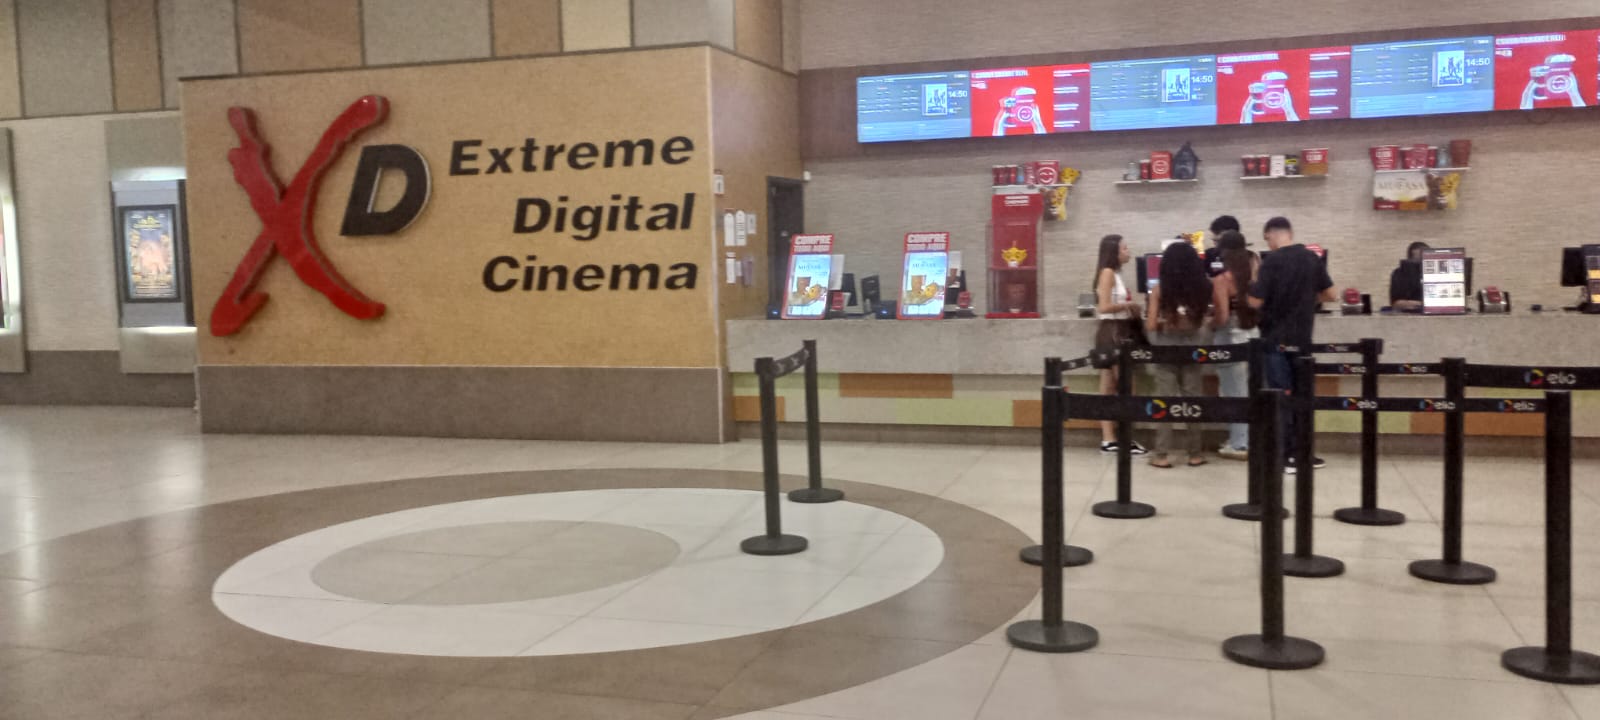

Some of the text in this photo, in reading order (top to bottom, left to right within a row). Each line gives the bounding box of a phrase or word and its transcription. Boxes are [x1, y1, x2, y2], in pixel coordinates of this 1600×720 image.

[1466, 58, 1490, 66] 14:50
[1191, 75, 1213, 83] 14:50
[948, 90, 968, 98] 14:50
[449, 135, 695, 176] Extreme
[211, 94, 432, 337] XD
[513, 192, 696, 241] Digital
[482, 255, 699, 293] Cinema
[1547, 371, 1577, 384] elo
[1169, 402, 1202, 417] elo
